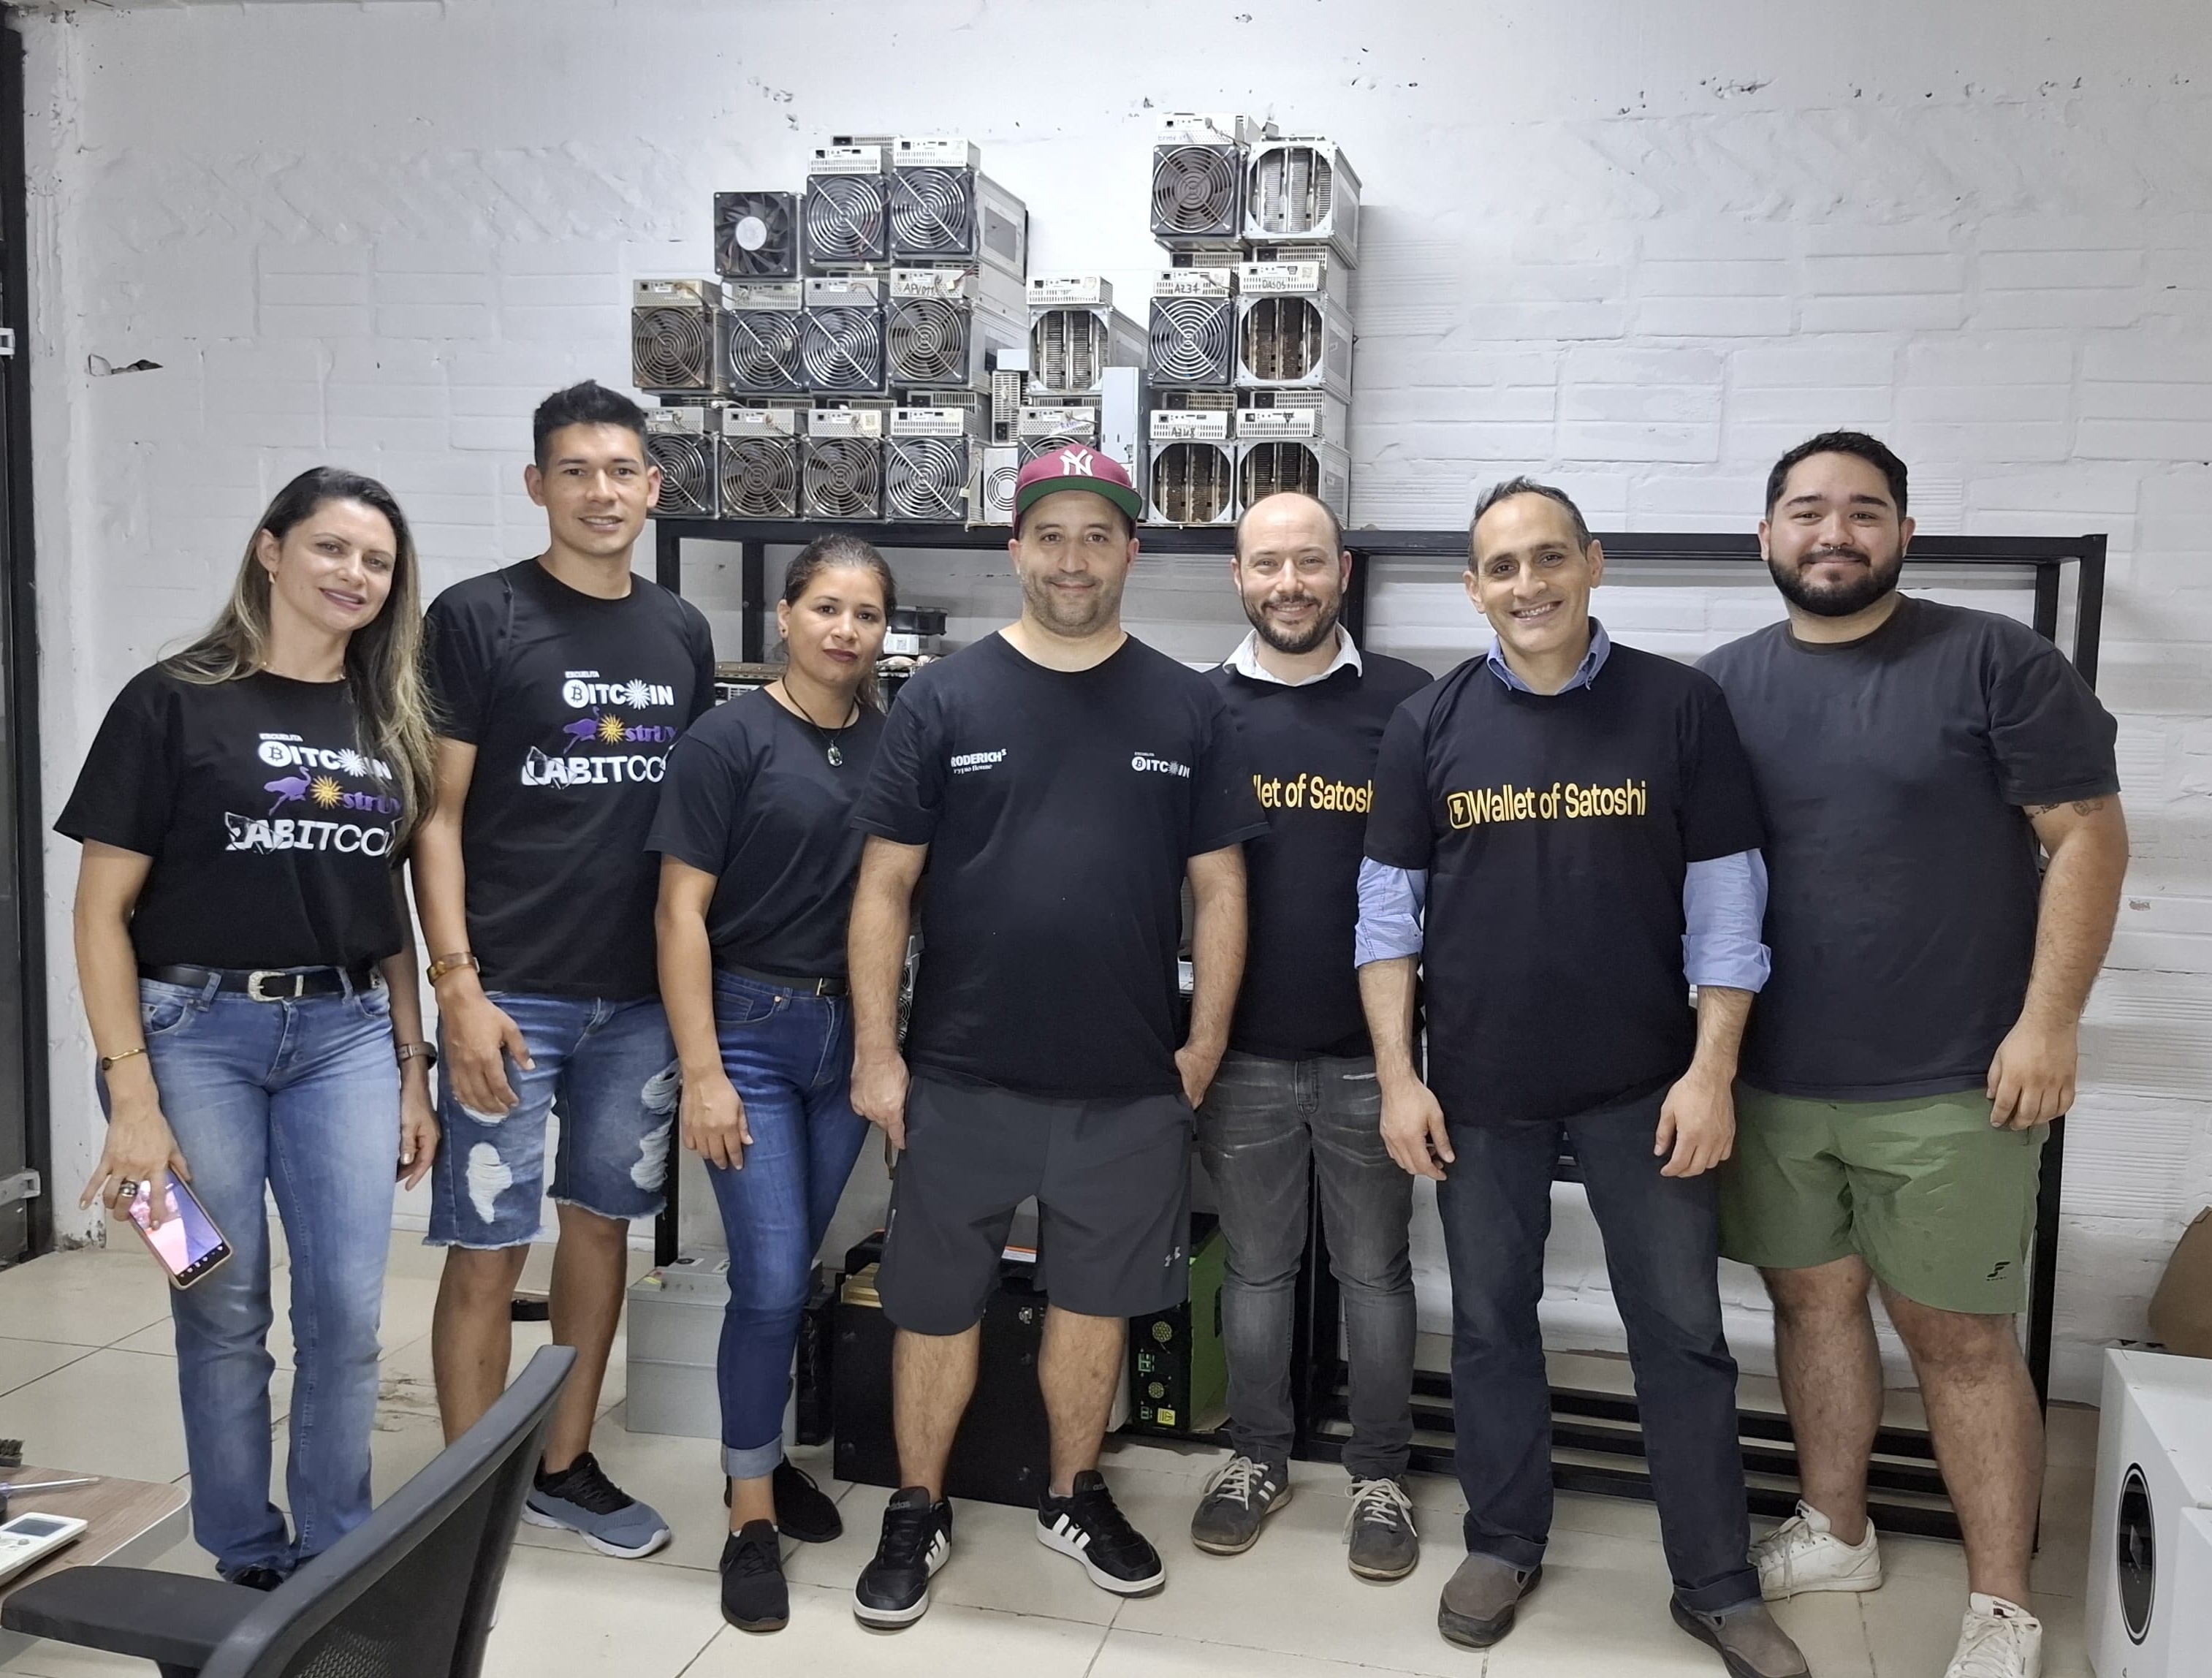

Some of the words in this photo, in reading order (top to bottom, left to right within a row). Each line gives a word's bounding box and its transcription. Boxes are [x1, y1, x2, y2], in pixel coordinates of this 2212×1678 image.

[1285, 772, 1307, 808] of
[1468, 784, 1536, 824] Wallet
[1540, 782, 1561, 819] of
[1565, 778, 1646, 819] Satoshi
